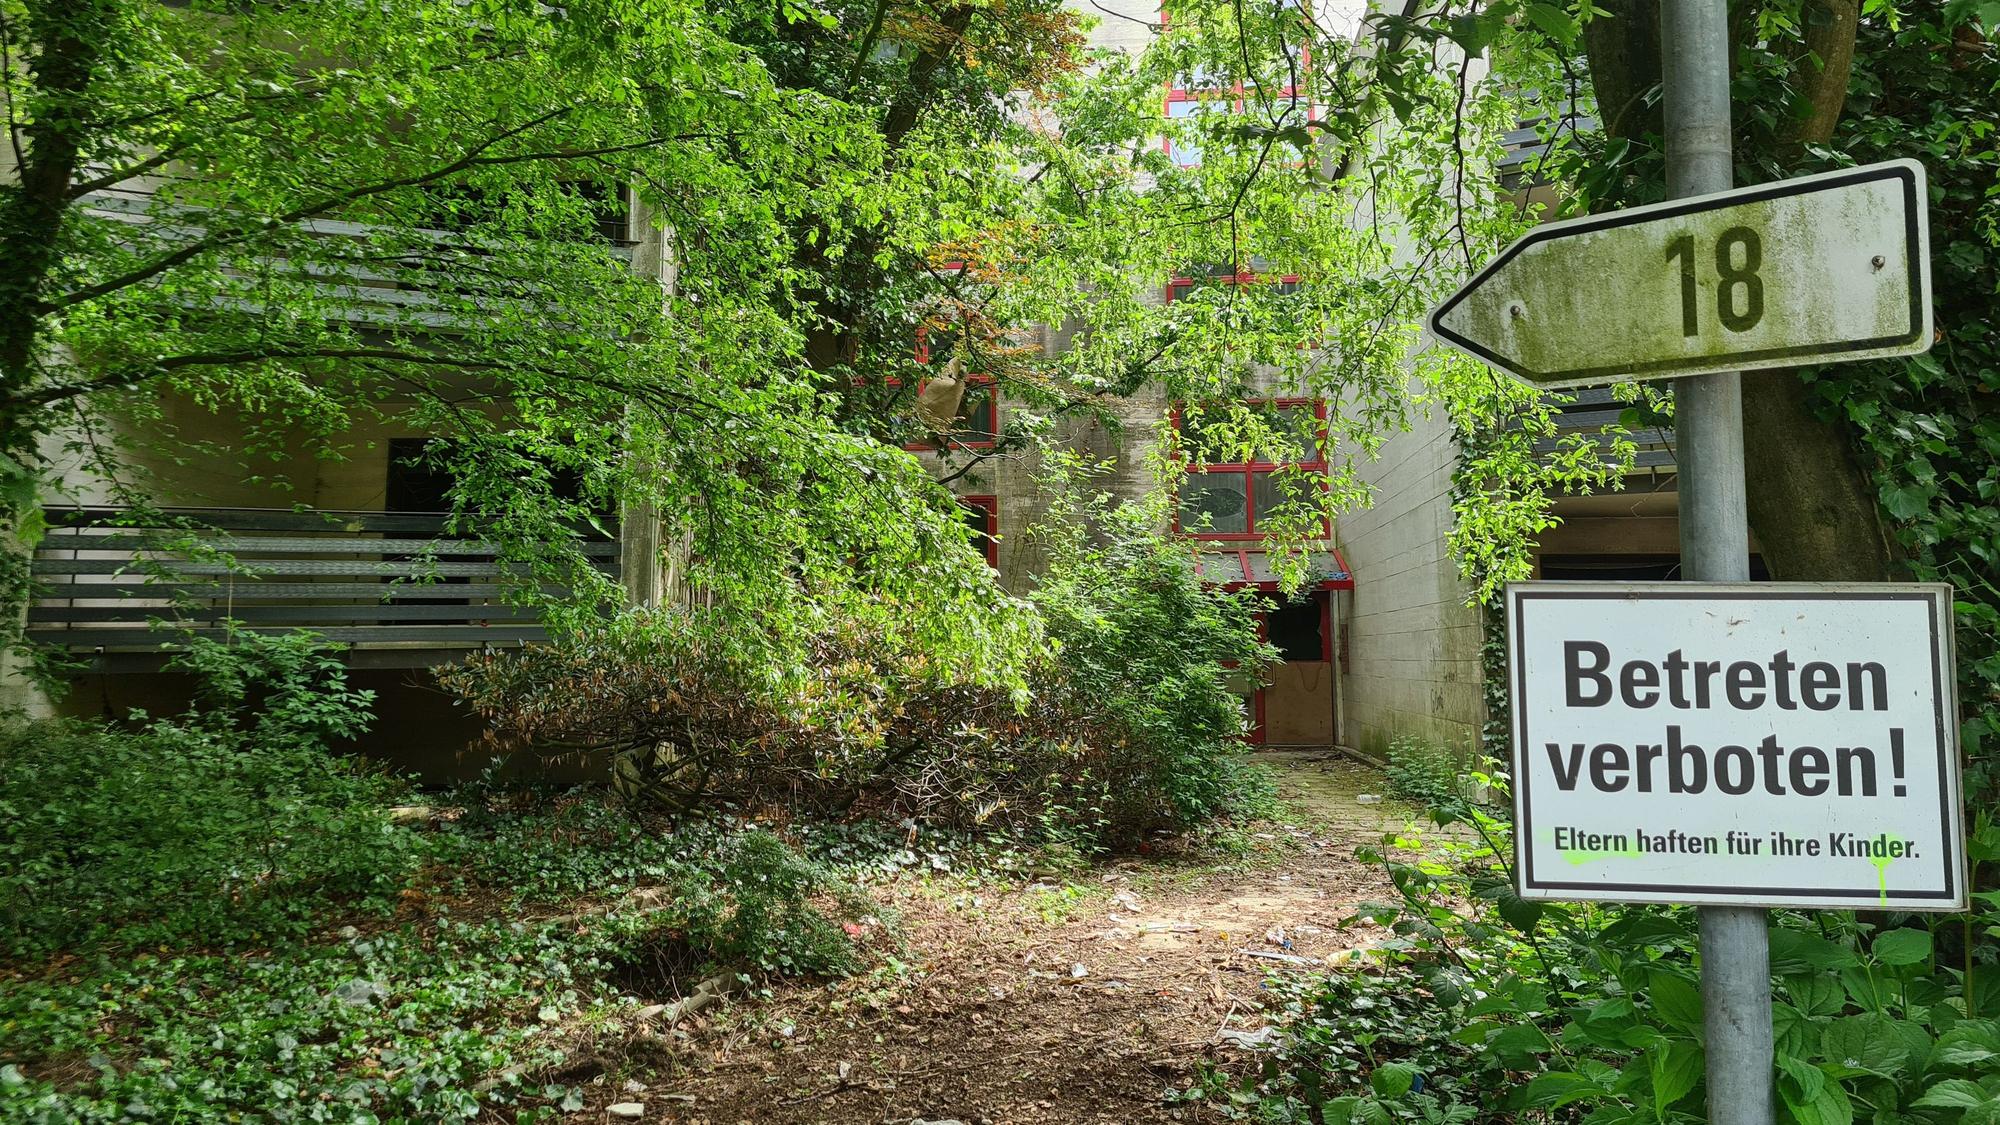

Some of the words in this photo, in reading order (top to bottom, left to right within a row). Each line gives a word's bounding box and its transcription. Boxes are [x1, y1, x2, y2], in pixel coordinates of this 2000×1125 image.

[1665, 225, 1764, 338] 18
[1563, 640, 1889, 712] Betreten
[1545, 725, 1908, 798] verboten!
[1553, 826, 1628, 852] Eltern
[1636, 828, 1719, 855] haften
[1725, 831, 1763, 856] für
[1770, 832, 1821, 857] ihre
[1829, 832, 1921, 860] Kinder.
